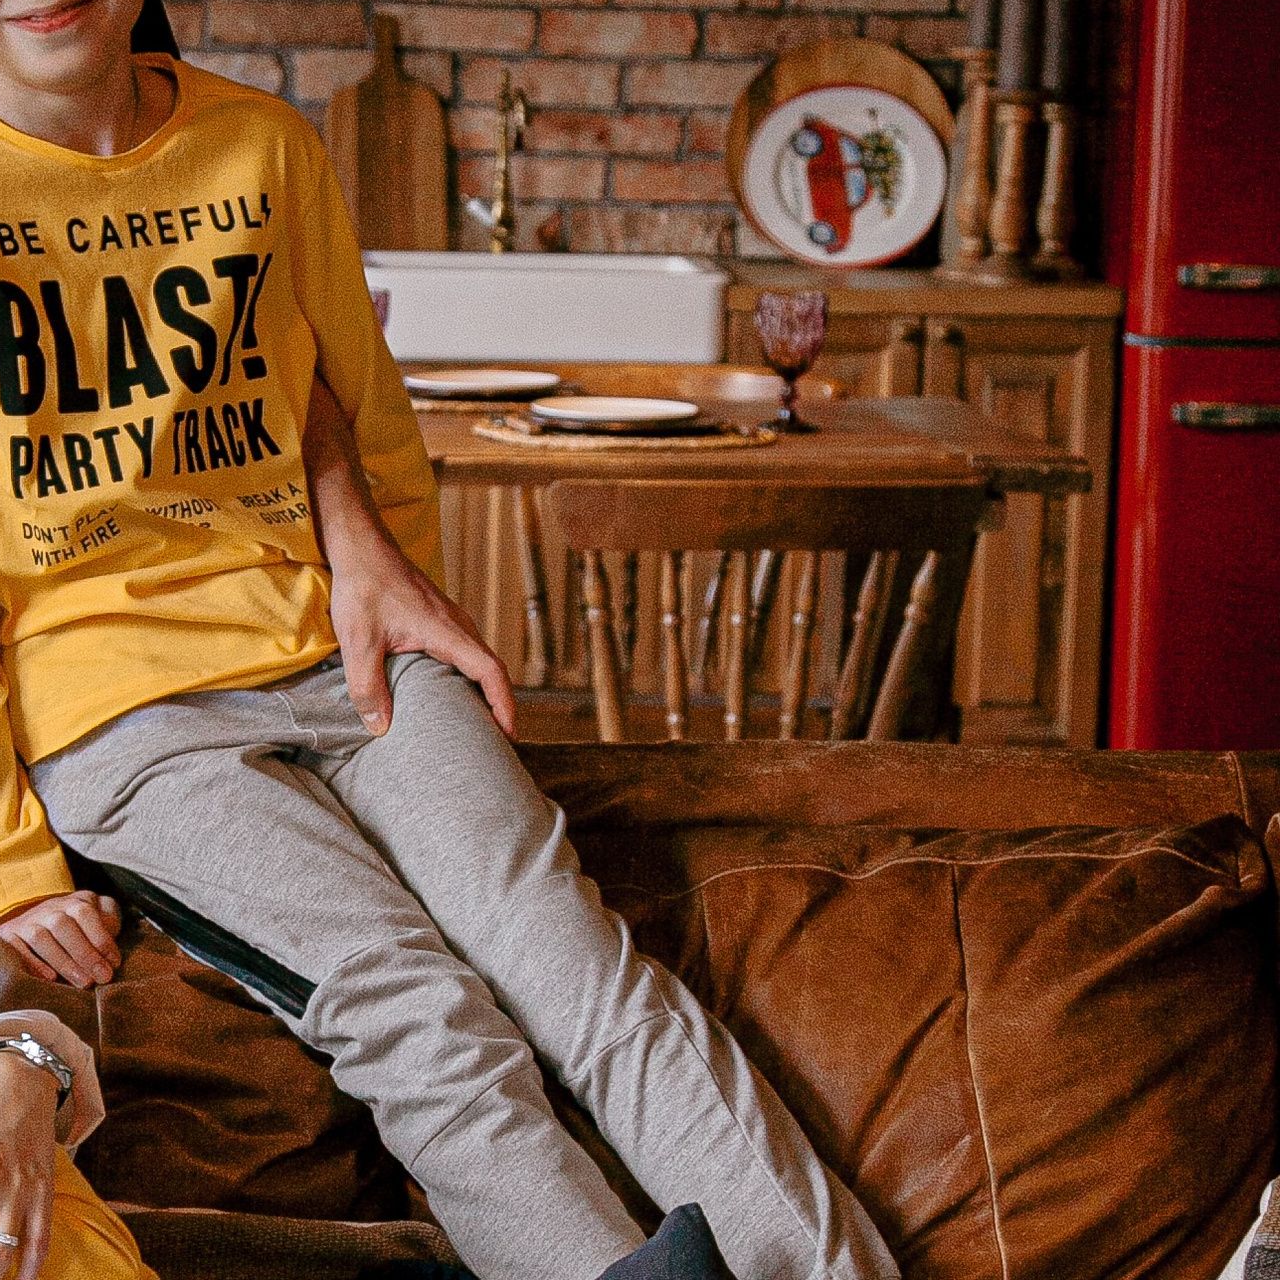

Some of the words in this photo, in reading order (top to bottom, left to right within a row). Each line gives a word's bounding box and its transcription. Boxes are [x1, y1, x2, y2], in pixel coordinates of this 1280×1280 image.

[66, 195, 262, 254] CAREFUL
[9, 416, 154, 500] PARTY
[173, 397, 283, 475] TRACK
[237, 486, 289, 508] BREAK
[287, 481, 303, 497] A
[259, 501, 312, 525] GUITAR
[22, 522, 70, 544] DON'T
[31, 546, 77, 567] WITH
[80, 517, 121, 554] FIRE
